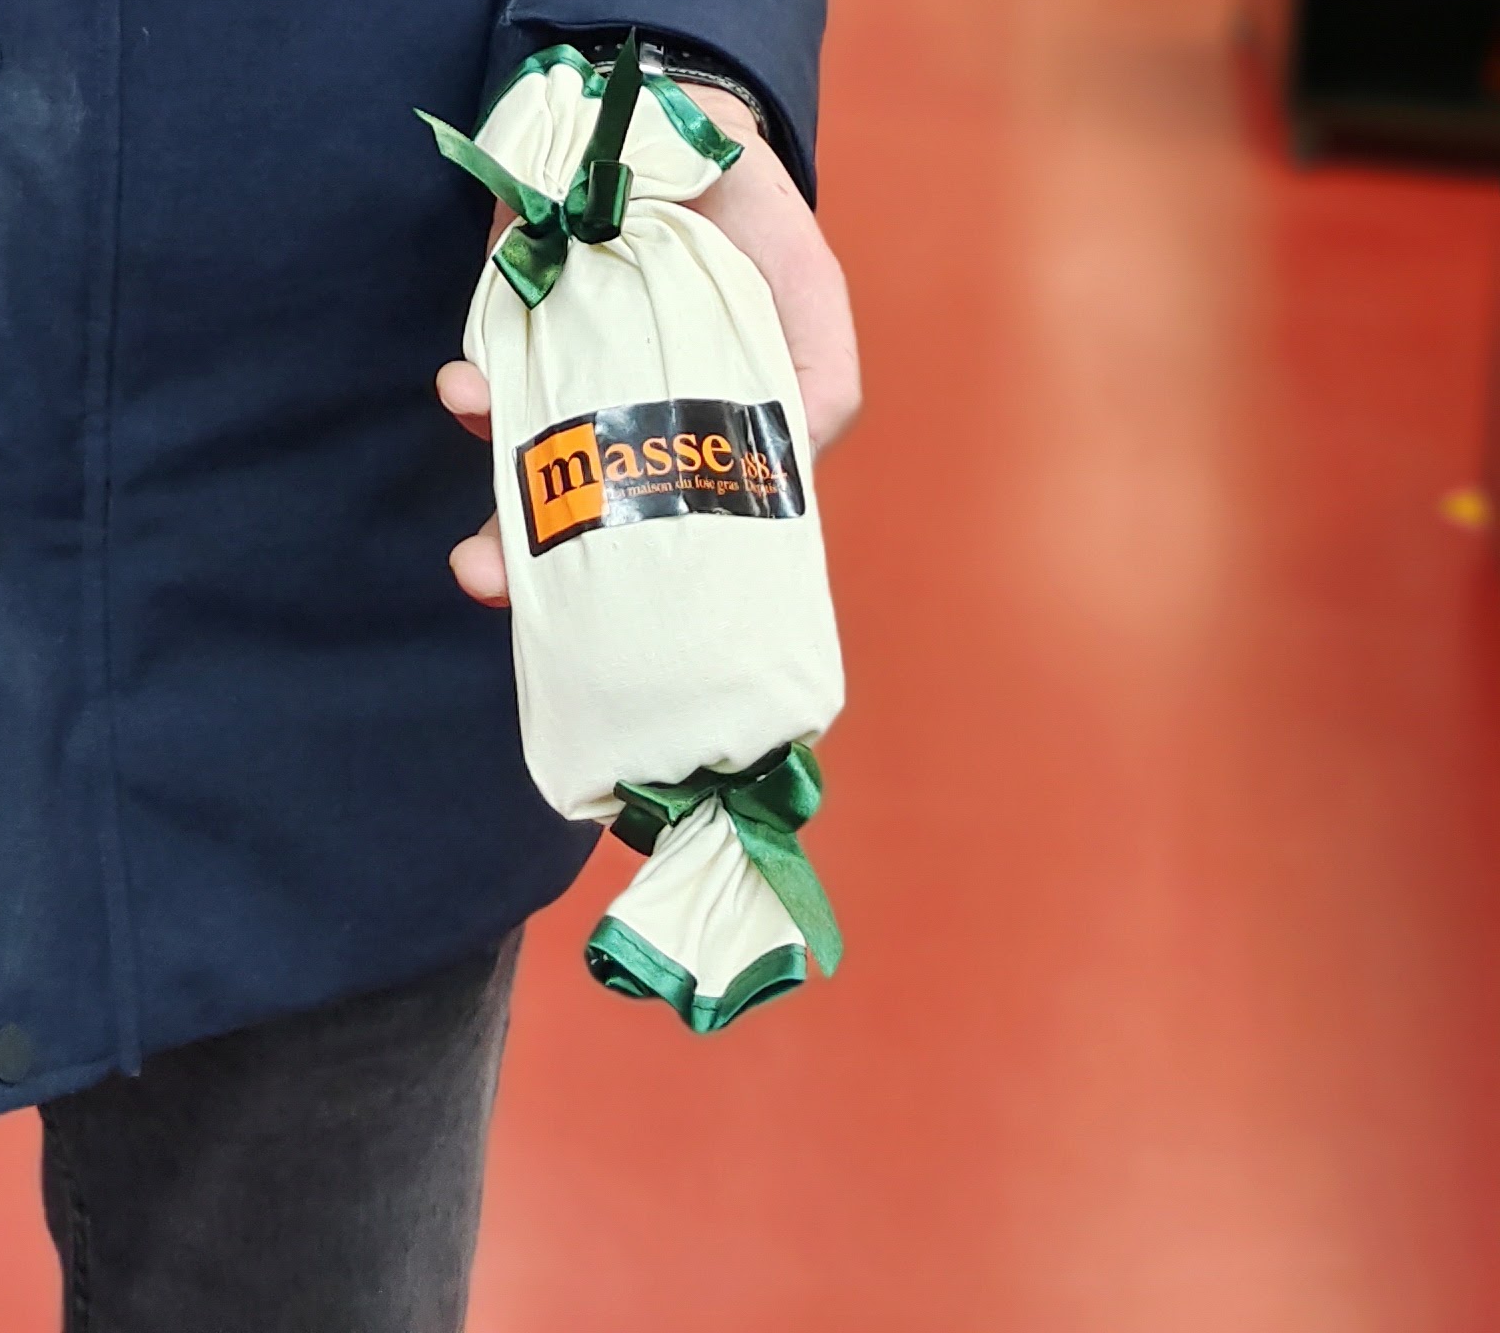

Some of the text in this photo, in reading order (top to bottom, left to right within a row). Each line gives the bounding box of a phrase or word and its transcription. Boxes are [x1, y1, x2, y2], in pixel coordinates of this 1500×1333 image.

[537, 433, 735, 504] masse
[628, 480, 674, 496] maison
[675, 476, 694, 490] du
[695, 474, 716, 490] foie
[717, 479, 740, 495] gras
